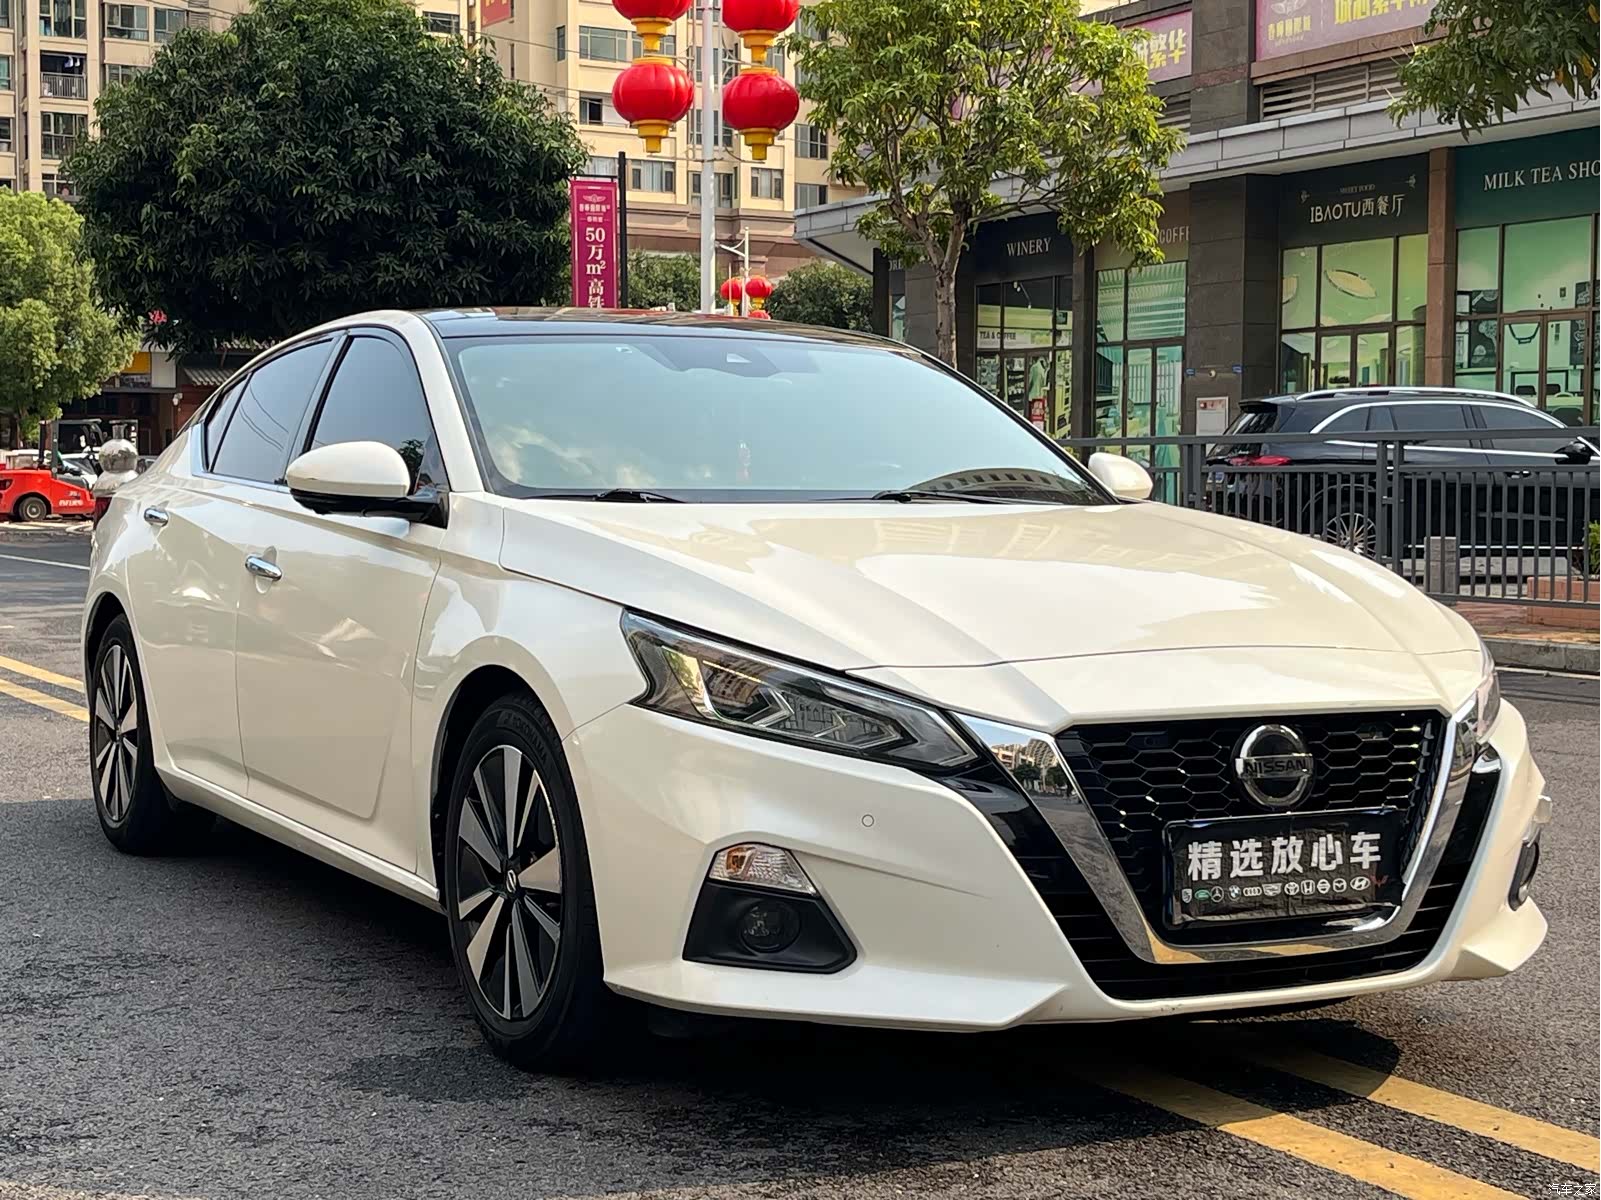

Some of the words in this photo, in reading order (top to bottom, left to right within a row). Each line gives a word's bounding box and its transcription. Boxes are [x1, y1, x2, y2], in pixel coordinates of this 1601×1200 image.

[1483, 169, 1526, 191] MILK
[1530, 165, 1563, 184] TEA
[1568, 159, 1600, 180] SHO
[1006, 236, 1052, 257] WINERY
[979, 331, 990, 340] TEA
[1244, 759, 1308, 776] NISSAN
[1187, 831, 1382, 881] 精选放心车
